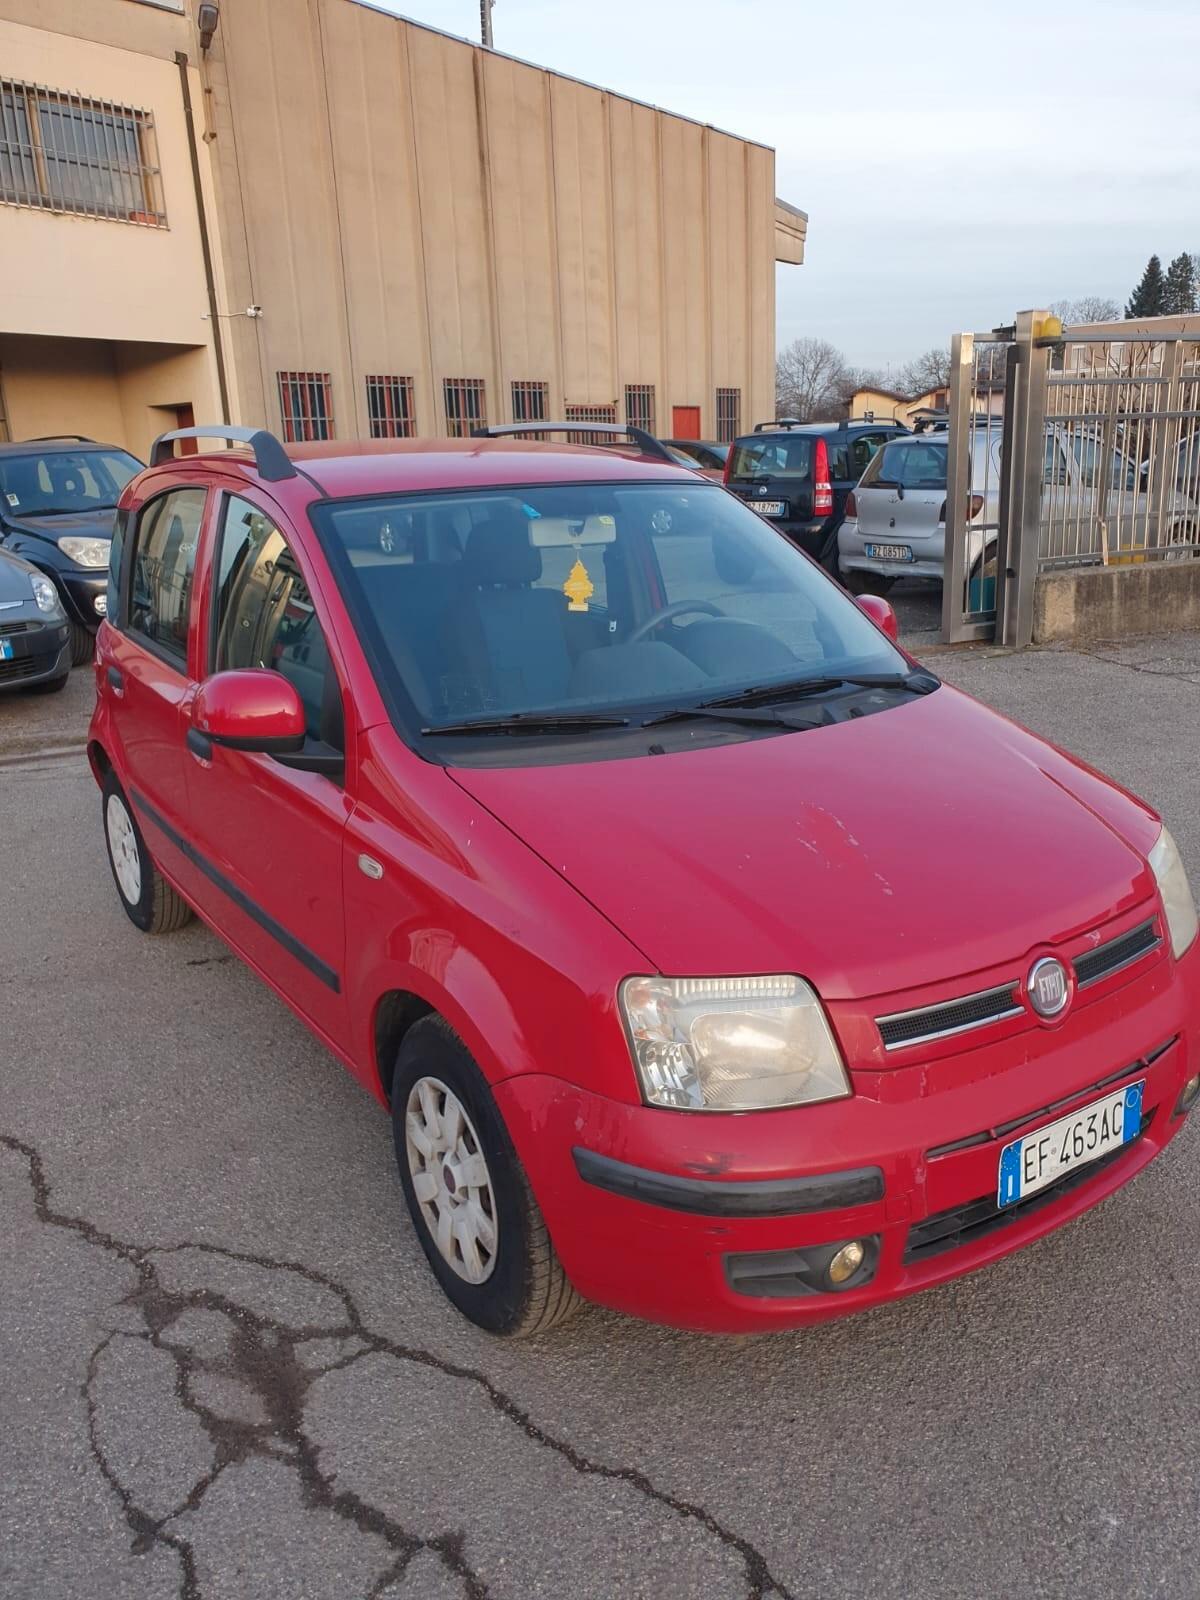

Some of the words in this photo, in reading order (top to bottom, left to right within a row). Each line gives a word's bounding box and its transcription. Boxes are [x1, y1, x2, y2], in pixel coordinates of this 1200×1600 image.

[1039, 971, 1061, 1003] FIAT
[1023, 1137, 1051, 1185] EF
[1059, 1101, 1123, 1165] 463AC
